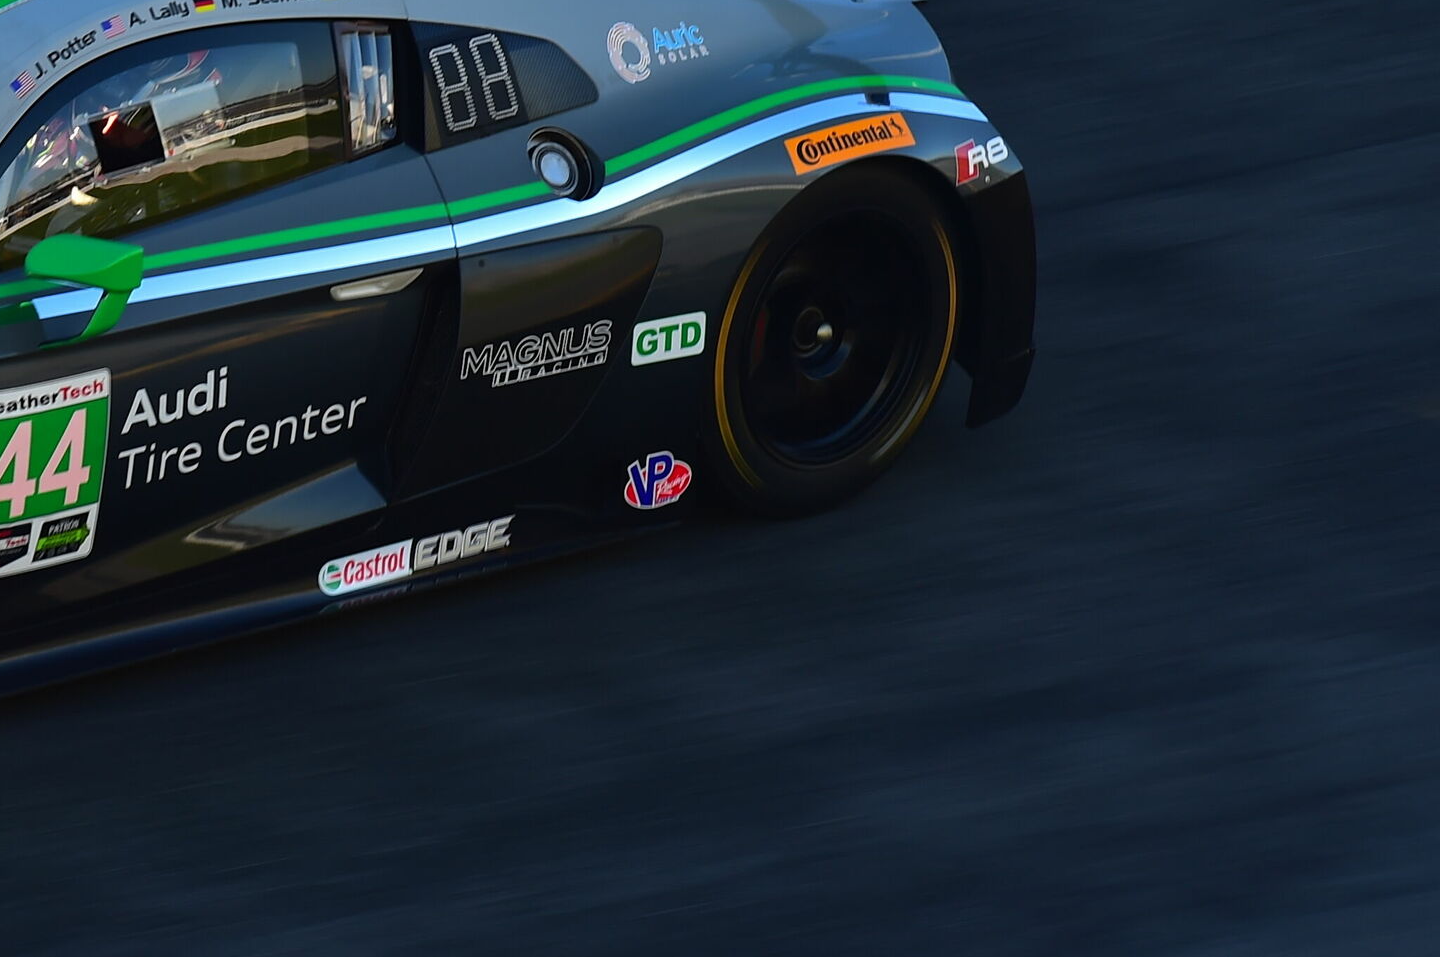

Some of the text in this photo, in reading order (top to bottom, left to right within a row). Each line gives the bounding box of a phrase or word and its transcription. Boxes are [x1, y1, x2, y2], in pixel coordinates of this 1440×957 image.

[34, 62, 48, 81] J.
[48, 29, 97, 69] Potter
[129, 12, 146, 28] A.
[150, 0, 191, 20] Lally
[653, 21, 704, 54] Auric
[658, 44, 710, 66] SOLAR
[796, 120, 893, 165] Continental
[967, 135, 1009, 176] R8
[460, 320, 613, 380] MAGNUS
[635, 321, 702, 357] GTD
[517, 350, 606, 382] RACING
[121, 366, 229, 435] Audi
[118, 396, 367, 490] Tire Center
[627, 452, 675, 508] VP
[343, 514, 516, 585] Castrol EDGE
